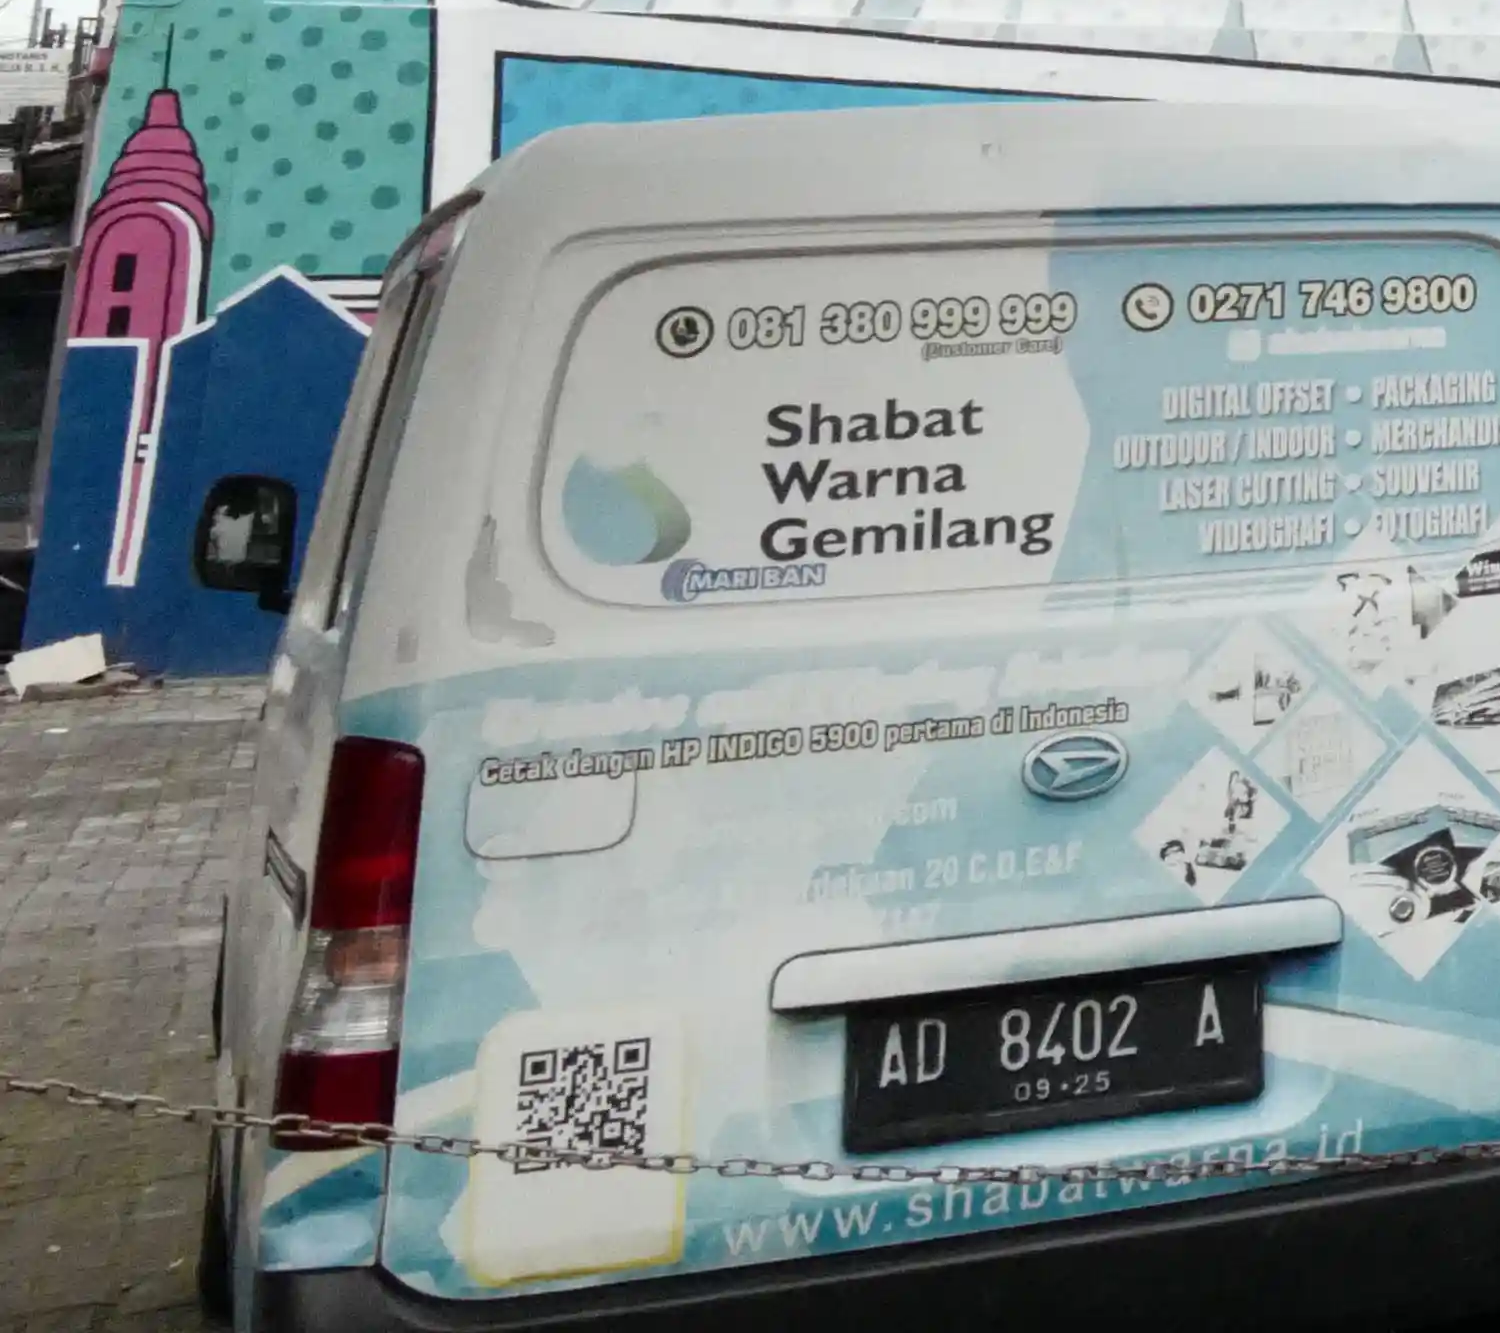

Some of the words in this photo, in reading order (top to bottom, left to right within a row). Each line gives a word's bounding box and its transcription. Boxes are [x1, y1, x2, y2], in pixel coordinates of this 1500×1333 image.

[728, 305, 805, 350] 081
[821, 301, 901, 344] 380
[911, 296, 990, 340] 999
[1000, 292, 1077, 334] 999
[1189, 282, 1284, 322] 0271
[1300, 277, 1372, 317] 746
[1382, 275, 1476, 313] 9800
[1162, 382, 1251, 421] DIGITAL
[1256, 379, 1336, 415] OFFSET
[1372, 370, 1497, 409] PACKAGING
[766, 399, 983, 448] Shabat
[1114, 432, 1225, 470] OUTDOOR
[1249, 425, 1335, 460] INDOOR
[761, 459, 966, 503] Warna
[1161, 474, 1229, 512] LASER
[1236, 467, 1335, 506] CUTTING
[1372, 459, 1480, 495] SOUVENIR
[760, 508, 1054, 561] Gemilang
[1202, 511, 1335, 553] VIDEOGRAFI
[687, 566, 759, 592] MARI
[762, 563, 826, 588] BAN
[481, 757, 558, 785] Cetak
[562, 747, 654, 781] dengan
[662, 738, 699, 768] HP
[708, 729, 802, 763] INDIGO
[810, 721, 879, 752] 5900
[884, 716, 982, 752] pertama
[990, 710, 1013, 734] di
[1019, 697, 1129, 733] Indonesia
[879, 1018, 947, 1089] AD
[999, 995, 1138, 1073] 8402
[1194, 985, 1225, 1047] A
